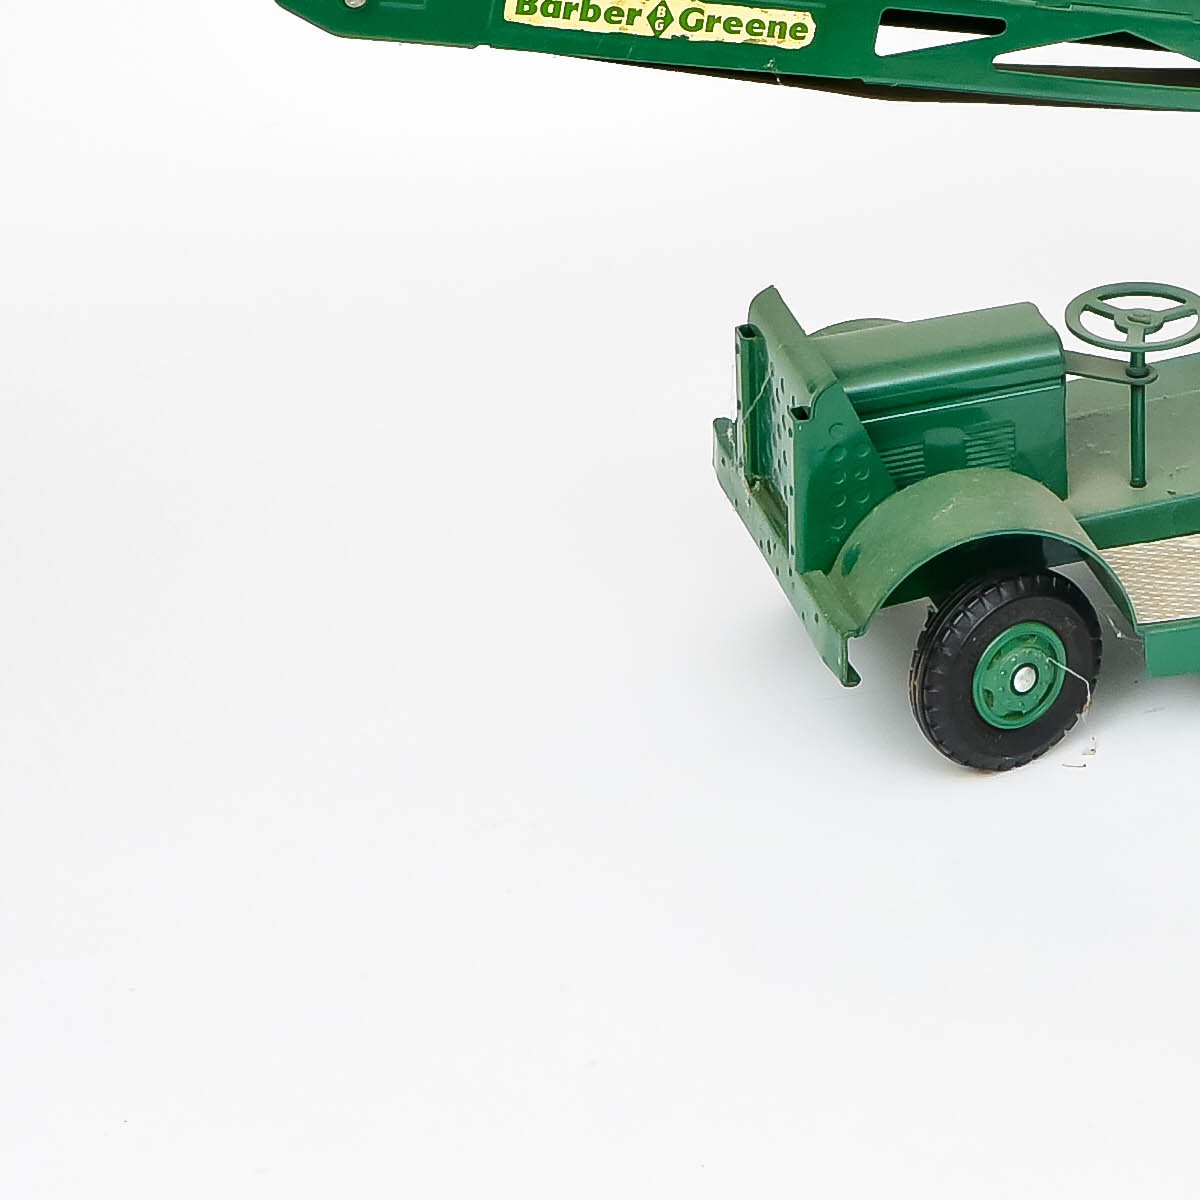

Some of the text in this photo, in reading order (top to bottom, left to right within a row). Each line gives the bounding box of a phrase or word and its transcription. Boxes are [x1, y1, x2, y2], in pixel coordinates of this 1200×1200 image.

[656, 6, 667, 18] B
[654, 19, 665, 31] G
[678, 7, 809, 41] Greene
